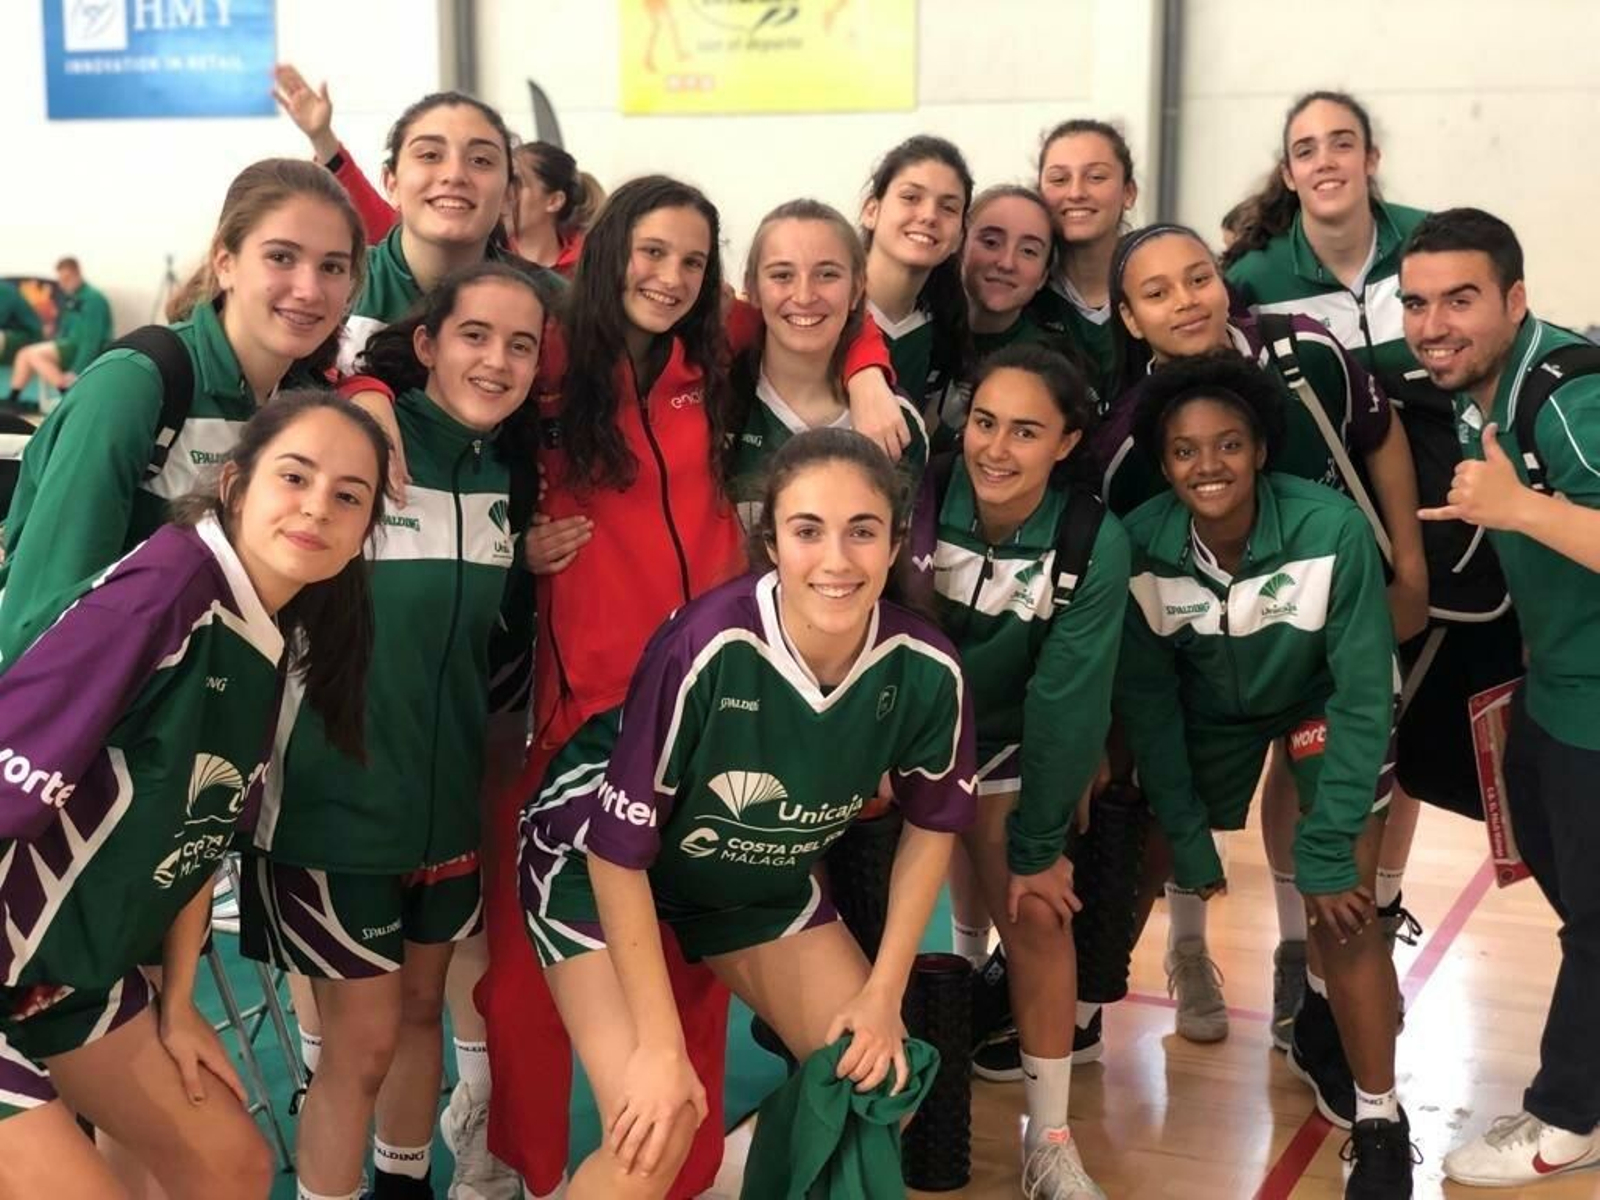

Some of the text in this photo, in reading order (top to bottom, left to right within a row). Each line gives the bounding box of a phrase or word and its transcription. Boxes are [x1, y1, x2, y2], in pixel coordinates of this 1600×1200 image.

[1291, 725, 1326, 750] wort
[727, 837, 786, 854] COSTA
[790, 841, 820, 854] DEL
